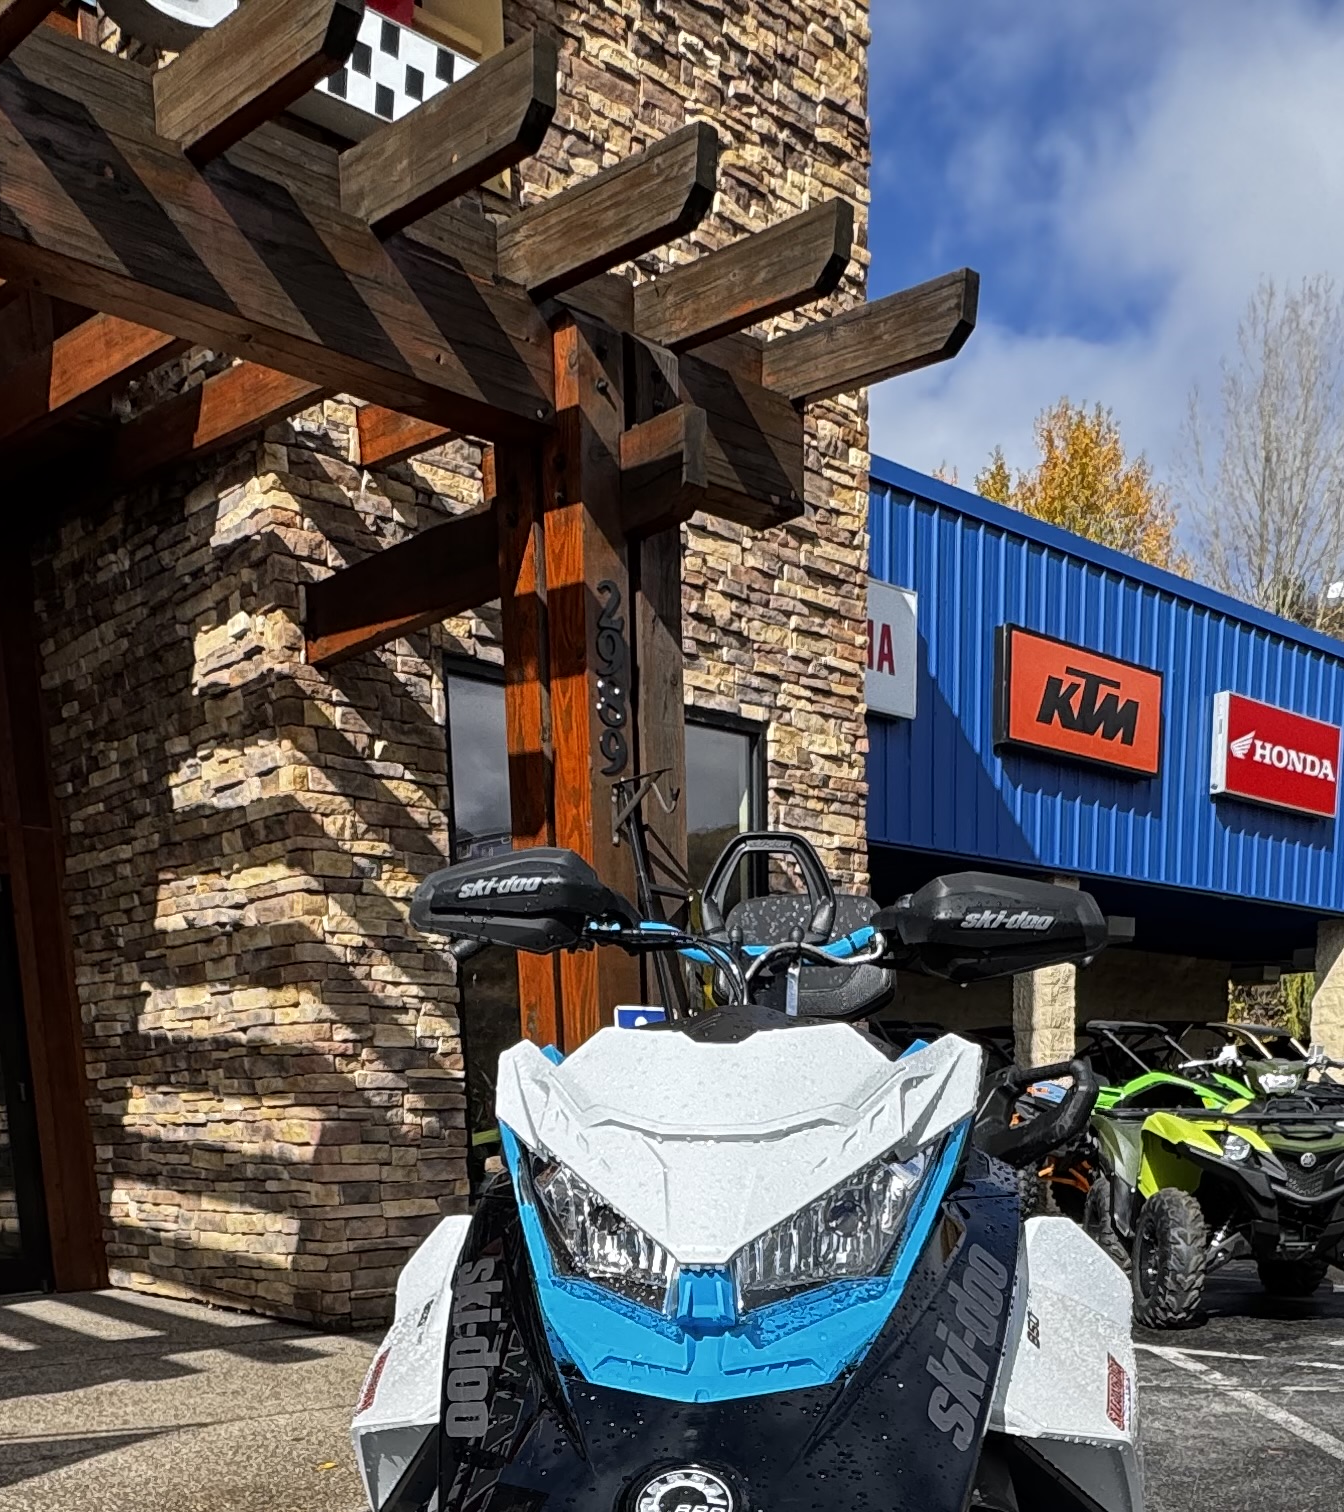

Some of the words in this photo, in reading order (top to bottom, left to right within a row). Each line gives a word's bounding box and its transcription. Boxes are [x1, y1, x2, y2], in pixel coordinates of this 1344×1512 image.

[596, 580, 628, 776] 2989
[1036, 665, 1140, 746] KTM
[1253, 739, 1336, 782] HONDA
[458, 875, 544, 899] ski-doo
[960, 910, 1055, 931] ski-doo
[445, 1257, 504, 1438] ski-doo
[925, 1243, 1008, 1452] ski-doo
[1027, 1311, 1041, 1349] 850
